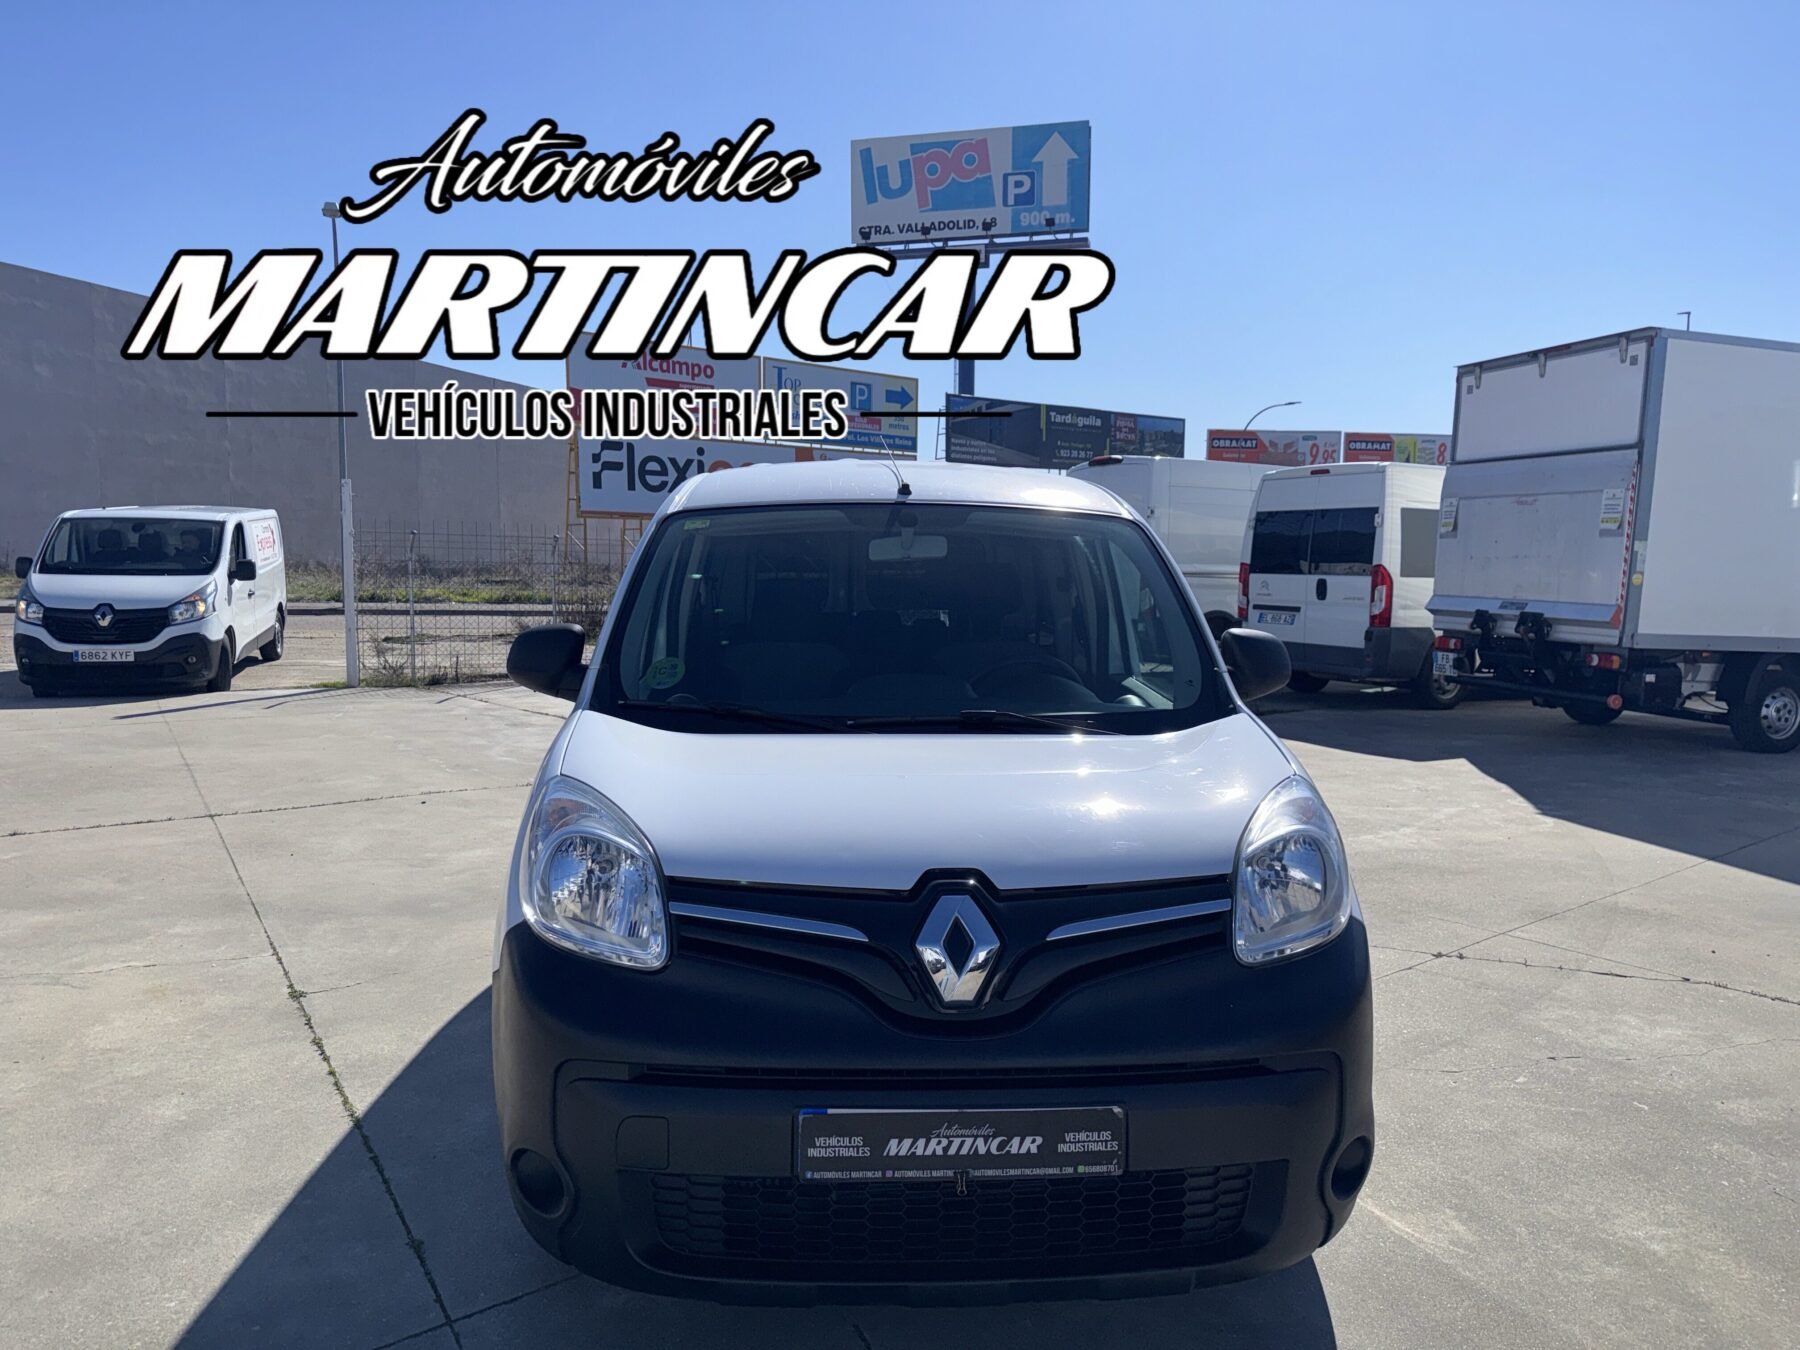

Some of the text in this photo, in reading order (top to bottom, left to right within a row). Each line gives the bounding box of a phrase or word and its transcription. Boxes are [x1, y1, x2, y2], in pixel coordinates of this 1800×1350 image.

[859, 137, 992, 209] lupa
[1007, 174, 1032, 206] P
[856, 384, 868, 409] P
[1212, 439, 1257, 448] OBRAMAT
[1349, 441, 1392, 450] OBRAMAT
[80, 651, 131, 661] 6862 KYF
[929, 1122, 996, 1138] Automóviles
[1065, 1130, 1112, 1142] VEHÍCULOS
[814, 1135, 864, 1147] VEHÍCULOS
[883, 1135, 1043, 1157] MARTINCAR
[1057, 1141, 1119, 1153] INDUSTRIALES
[807, 1147, 871, 1158] INDUSTRIALES
